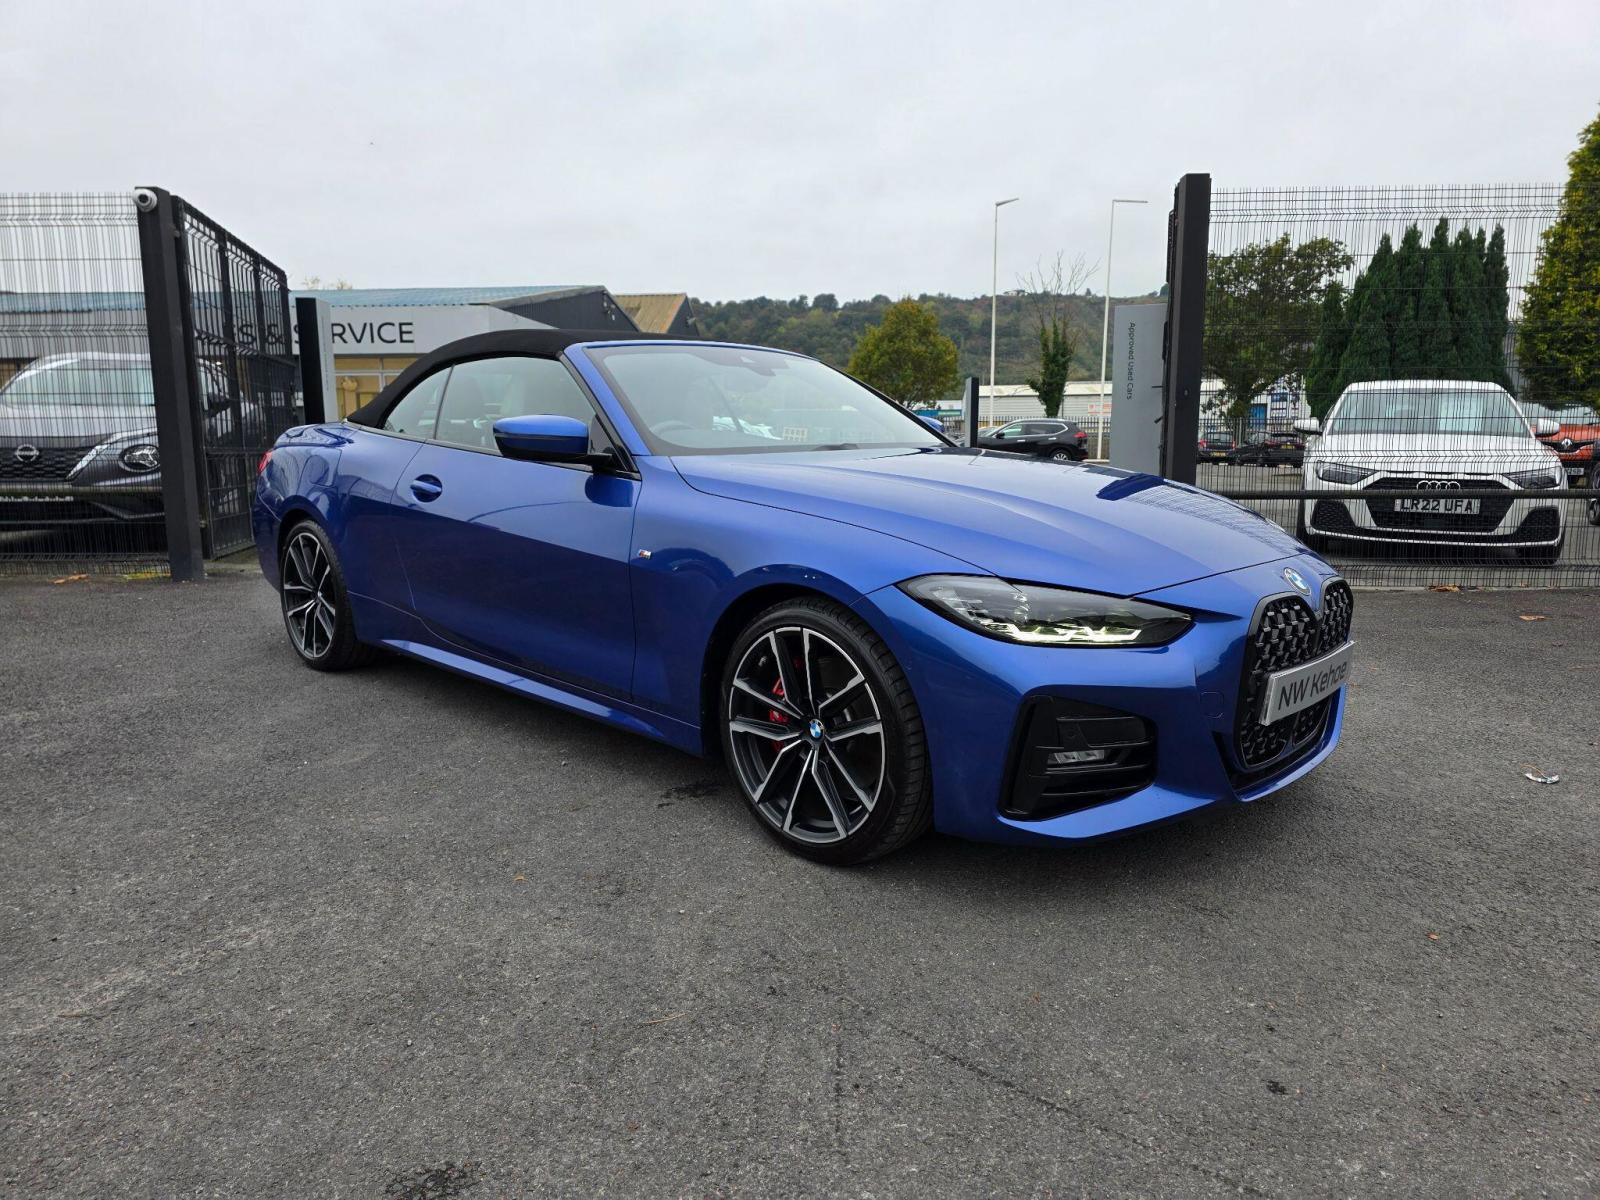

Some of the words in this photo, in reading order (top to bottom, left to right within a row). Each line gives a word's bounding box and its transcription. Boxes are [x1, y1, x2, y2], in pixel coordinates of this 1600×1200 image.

[1128, 322, 1136, 360] Approved
[1126, 382, 1134, 400] Cars
[1400, 499, 1440, 511] LR22
[1445, 499, 1473, 512] UFA
[1278, 675, 1310, 710] NW
[1310, 661, 1347, 698] Kehoe
